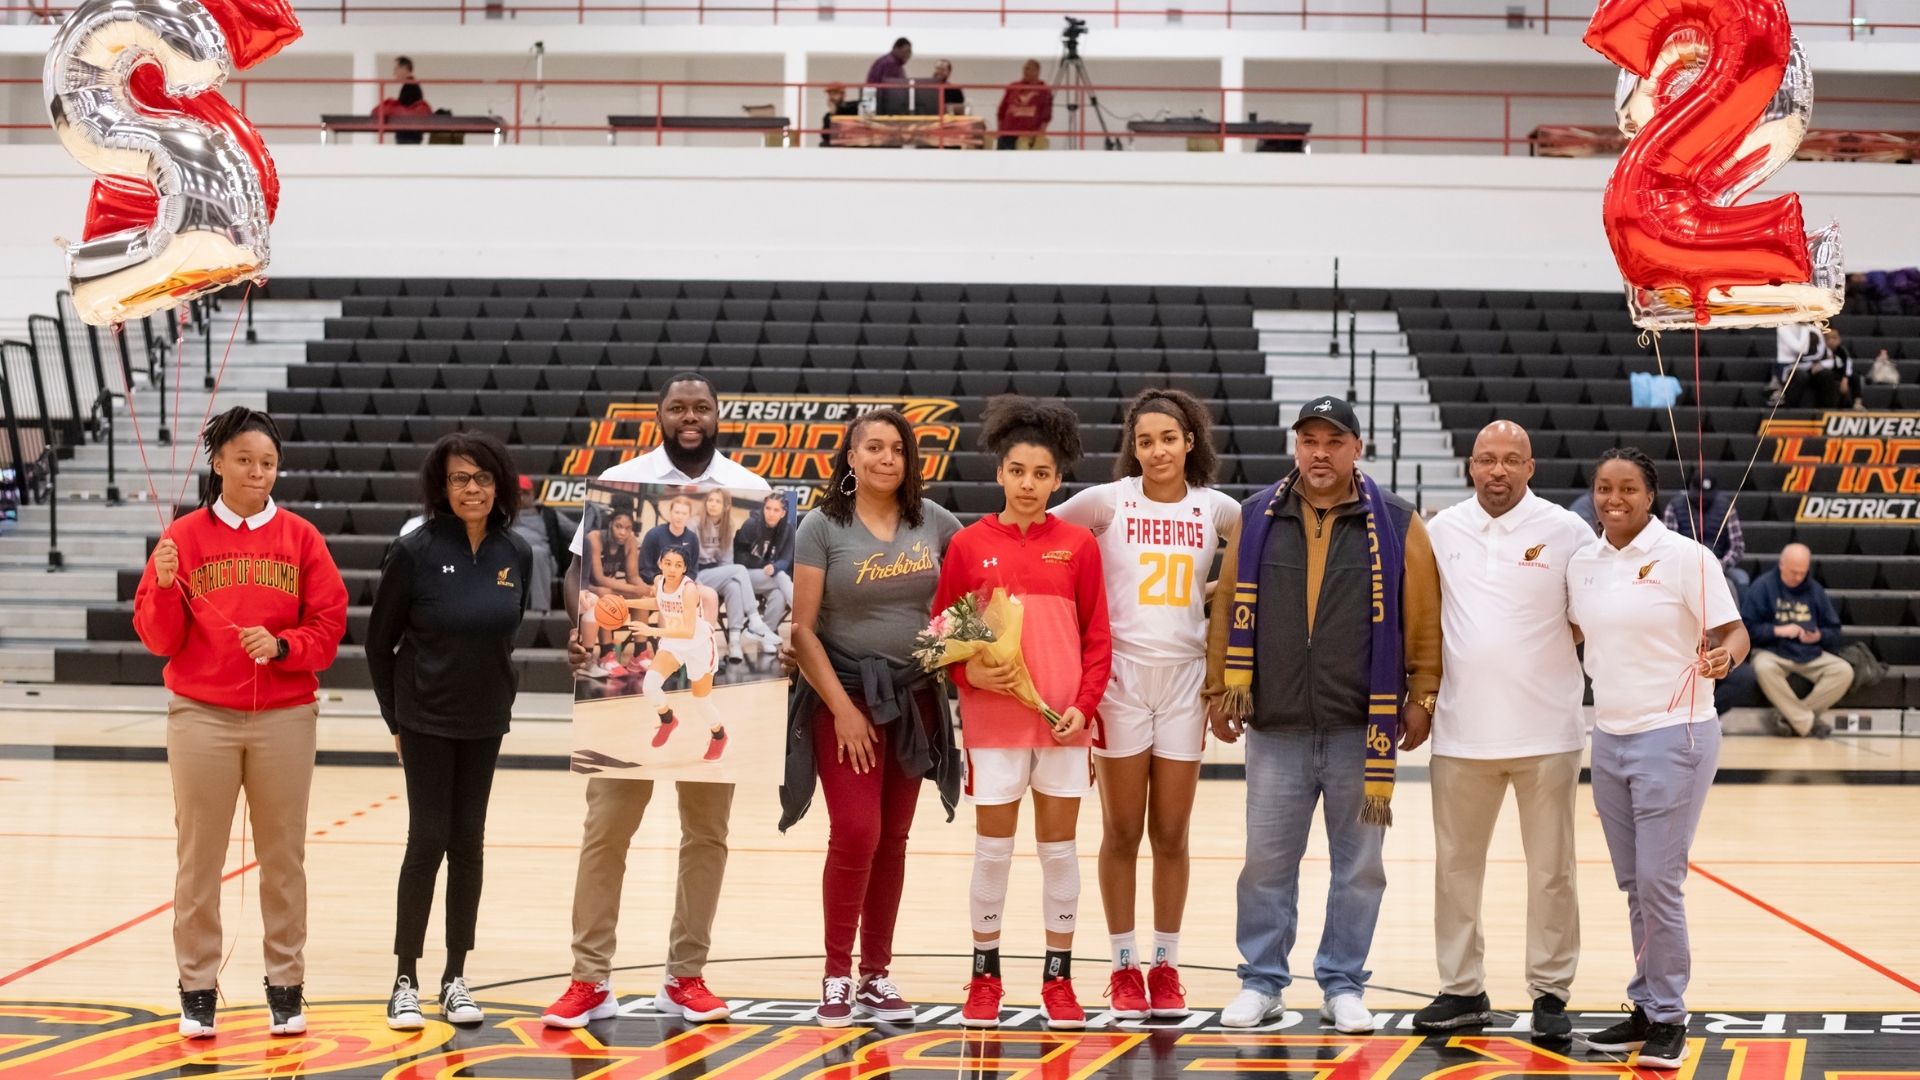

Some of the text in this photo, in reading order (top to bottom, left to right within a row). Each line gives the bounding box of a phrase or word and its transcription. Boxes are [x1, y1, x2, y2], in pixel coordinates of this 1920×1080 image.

[824, 404, 850, 420] OF
[1803, 497, 1916, 519] DISTRICT
[1126, 517, 1204, 549] FIREBIRDS
[274, 553, 292, 563] THE
[853, 546, 934, 585] Firebirds
[237, 559, 250, 585] OF
[254, 560, 299, 598] COLUMBI
[1138, 552, 1195, 607] 20
